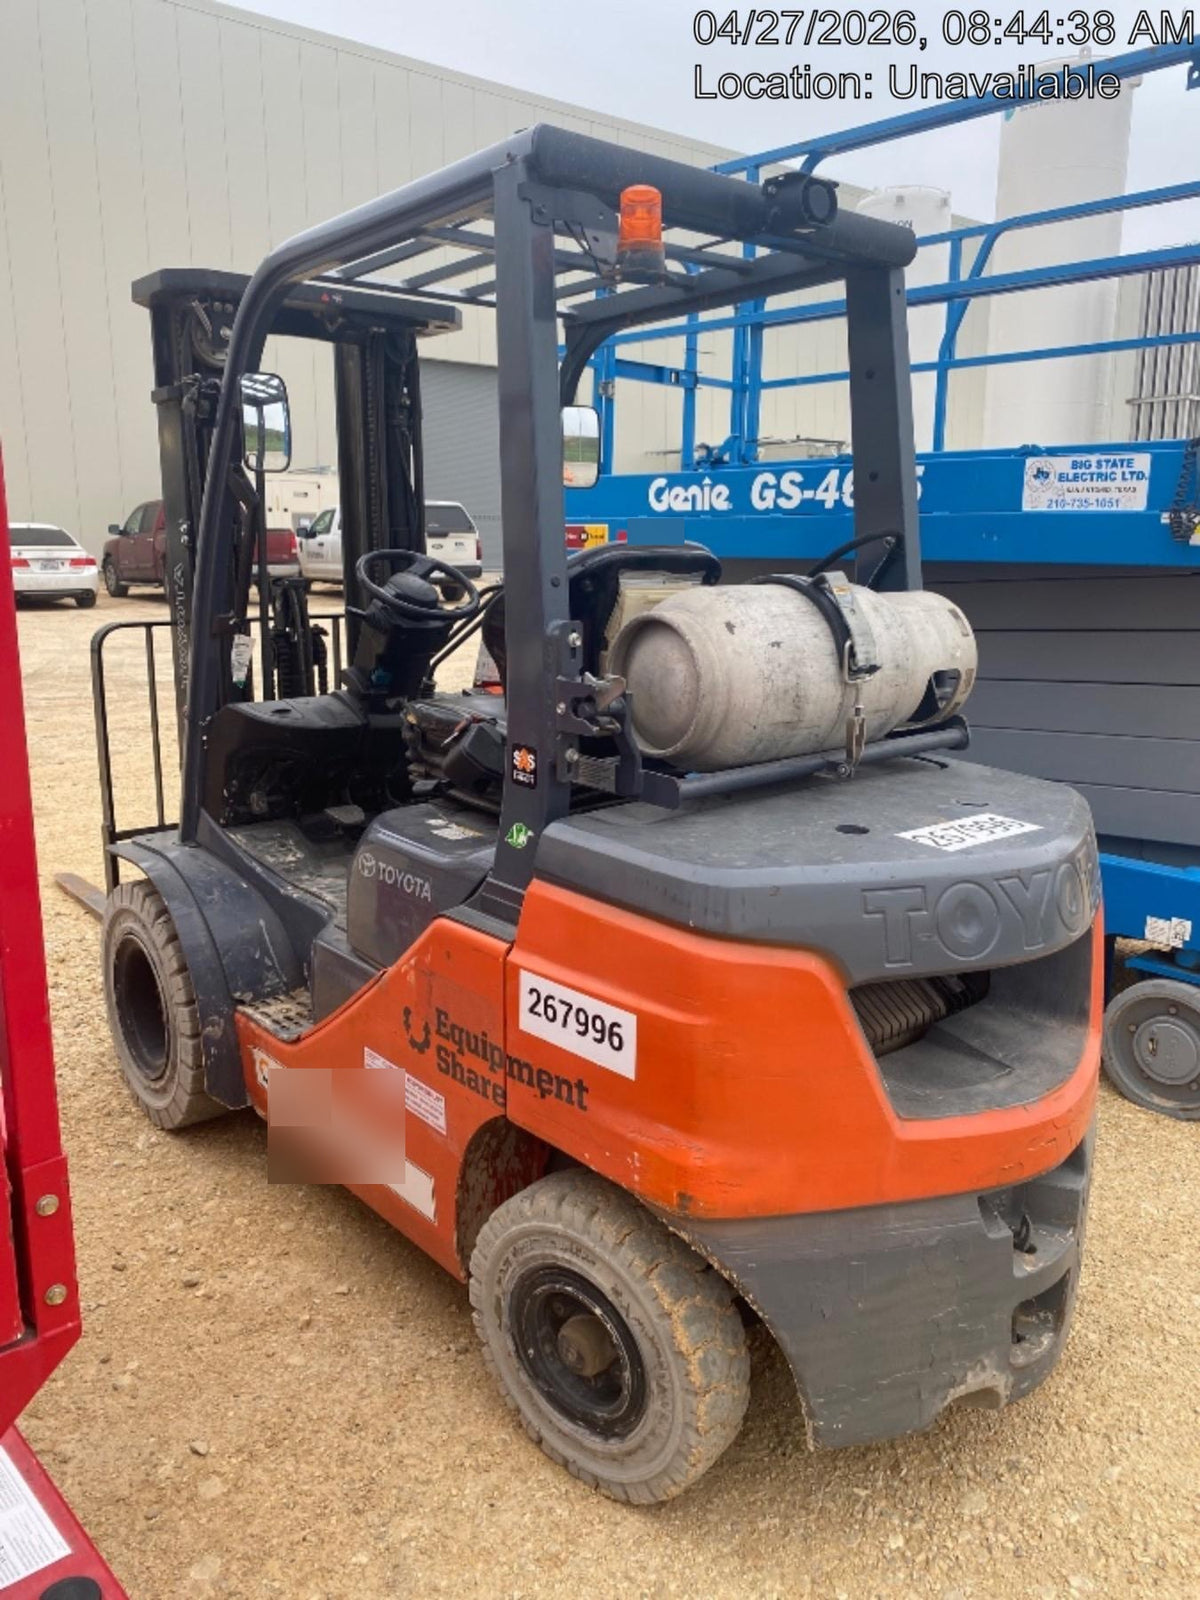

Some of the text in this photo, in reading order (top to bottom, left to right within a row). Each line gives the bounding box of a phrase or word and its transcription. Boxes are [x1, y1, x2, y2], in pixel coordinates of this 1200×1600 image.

[648, 464, 926, 513] Genie GS-4
[1057, 470, 1147, 482] ELECTRIC LTD.
[1071, 458, 1135, 470] BIG STATE
[378, 861, 432, 902] TOYOTA
[528, 986, 624, 1052] 267996
[435, 1006, 589, 1112] Equipment
[436, 1043, 507, 1108] Share
